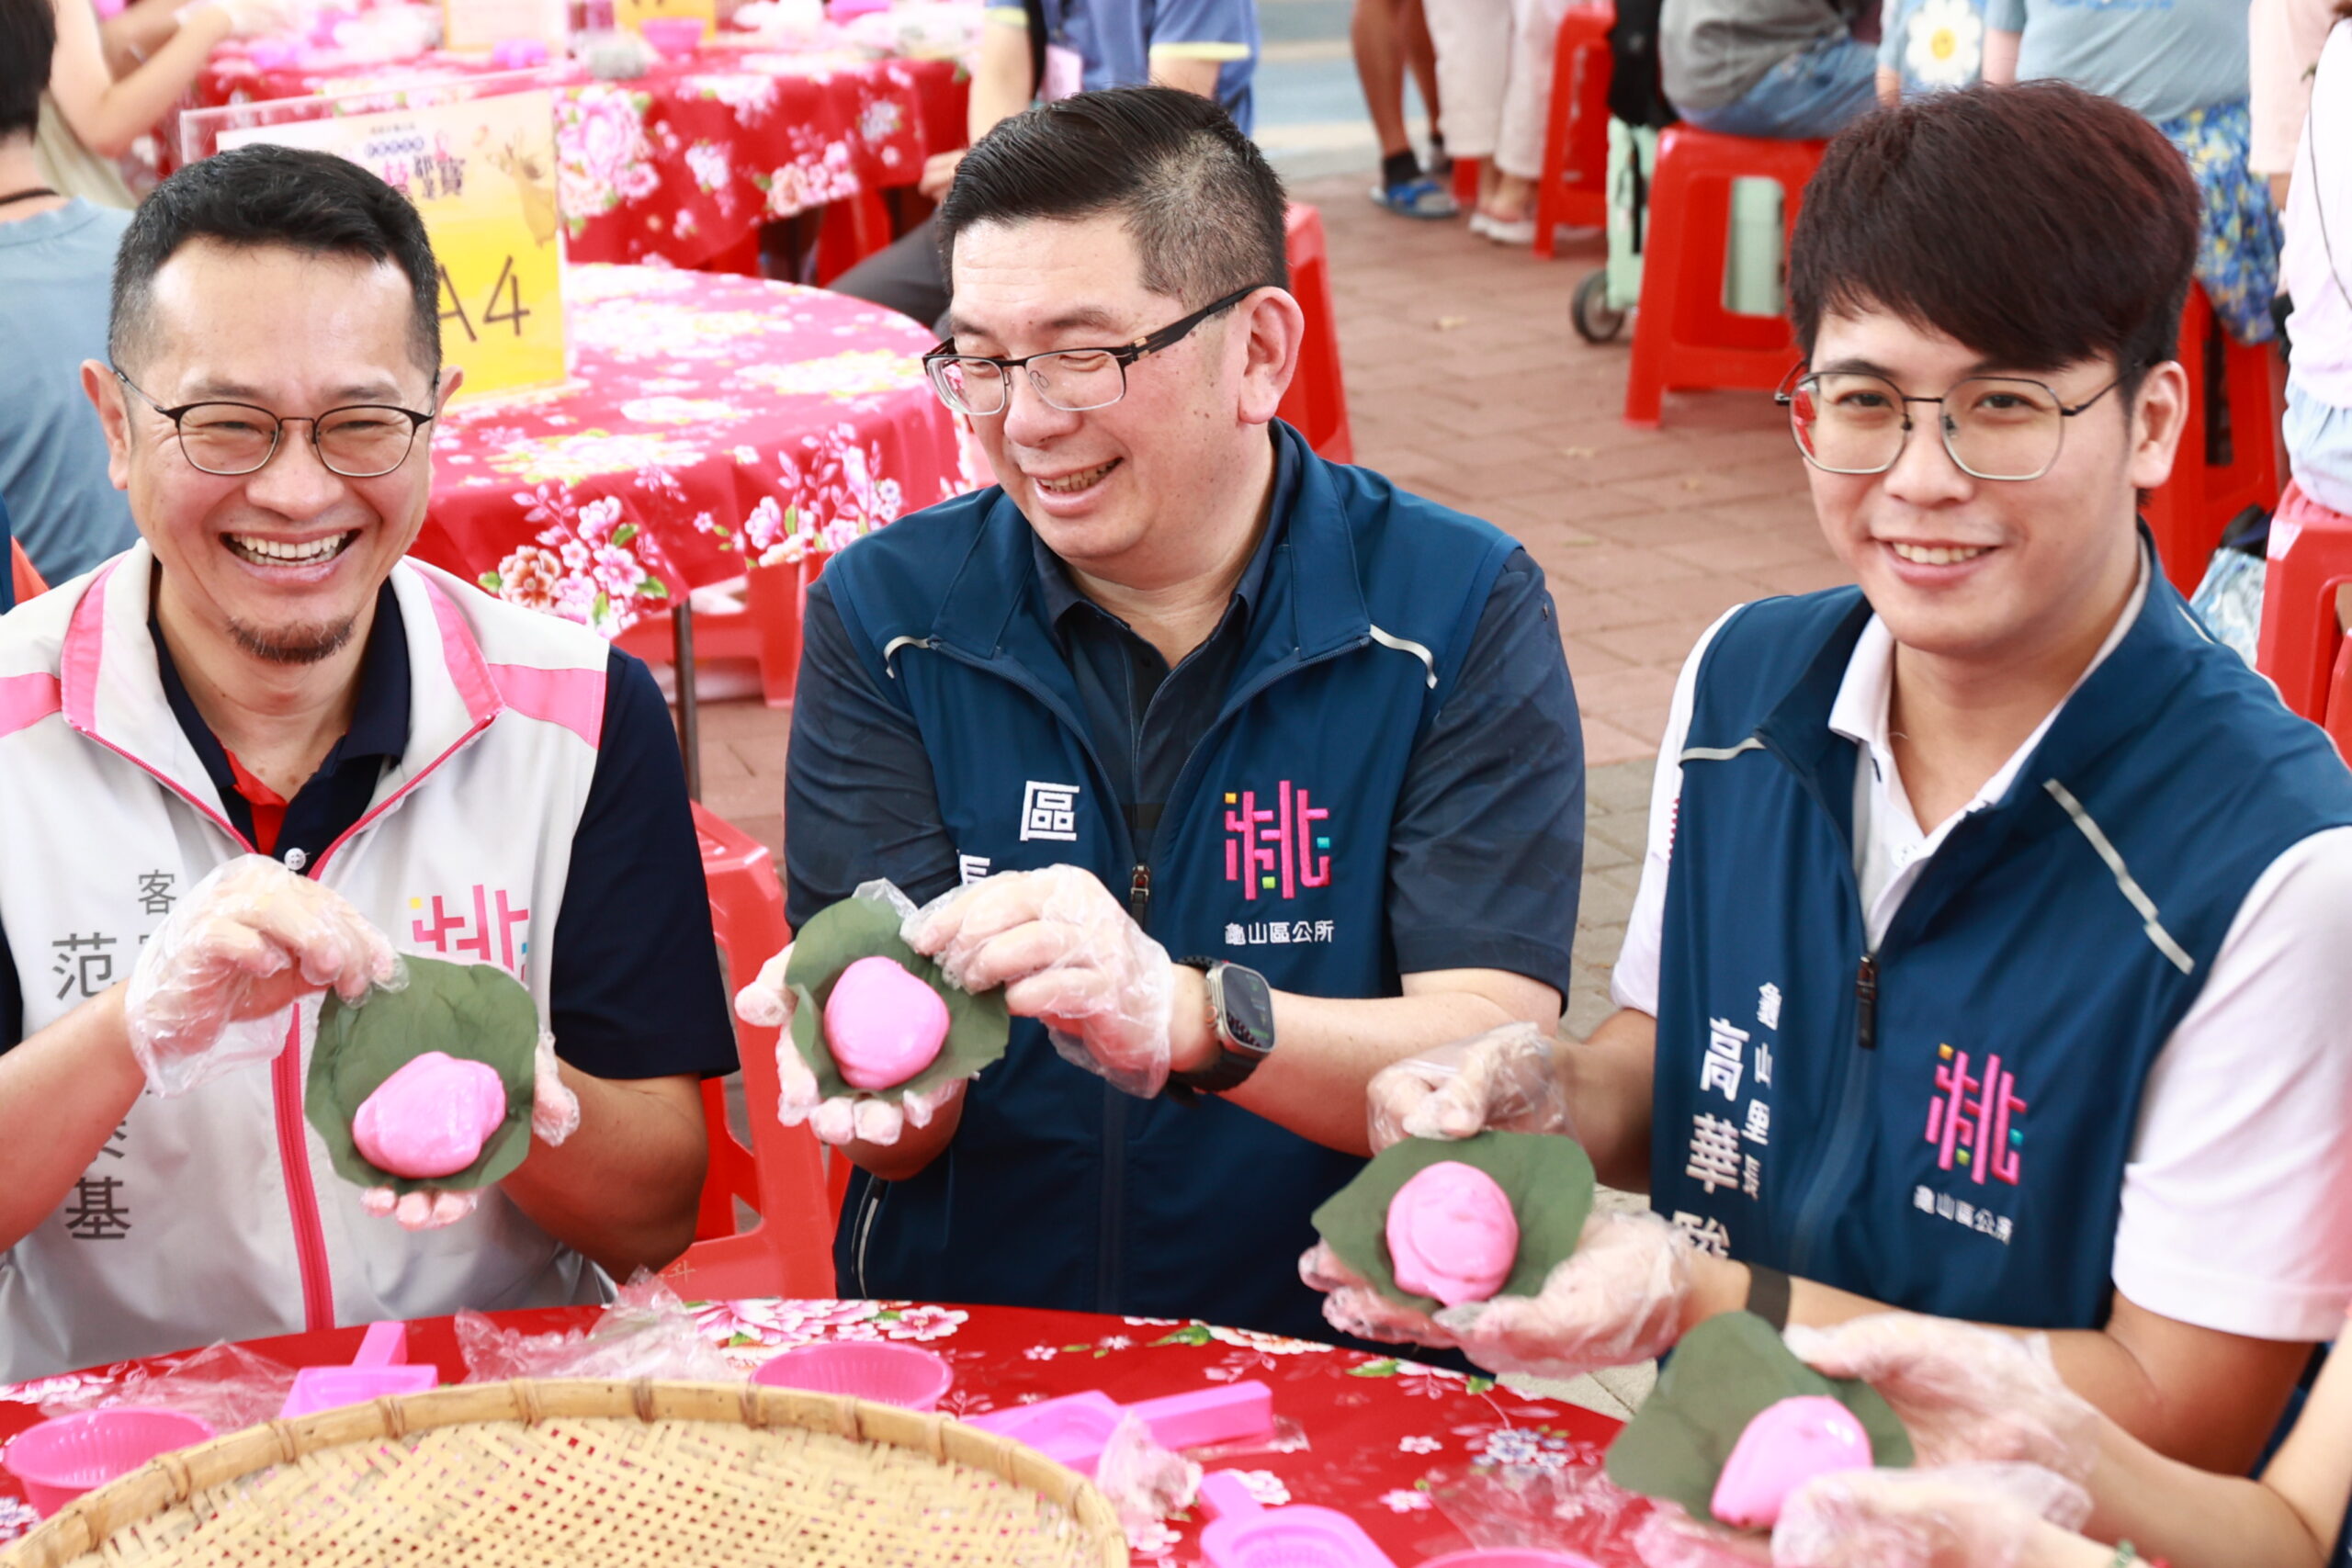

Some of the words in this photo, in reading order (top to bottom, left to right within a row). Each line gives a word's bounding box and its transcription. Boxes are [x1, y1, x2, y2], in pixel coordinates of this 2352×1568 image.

[437, 254, 531, 342] A4
[1020, 780, 1080, 841] 區
[1225, 919, 1335, 946] 龜山區公所
